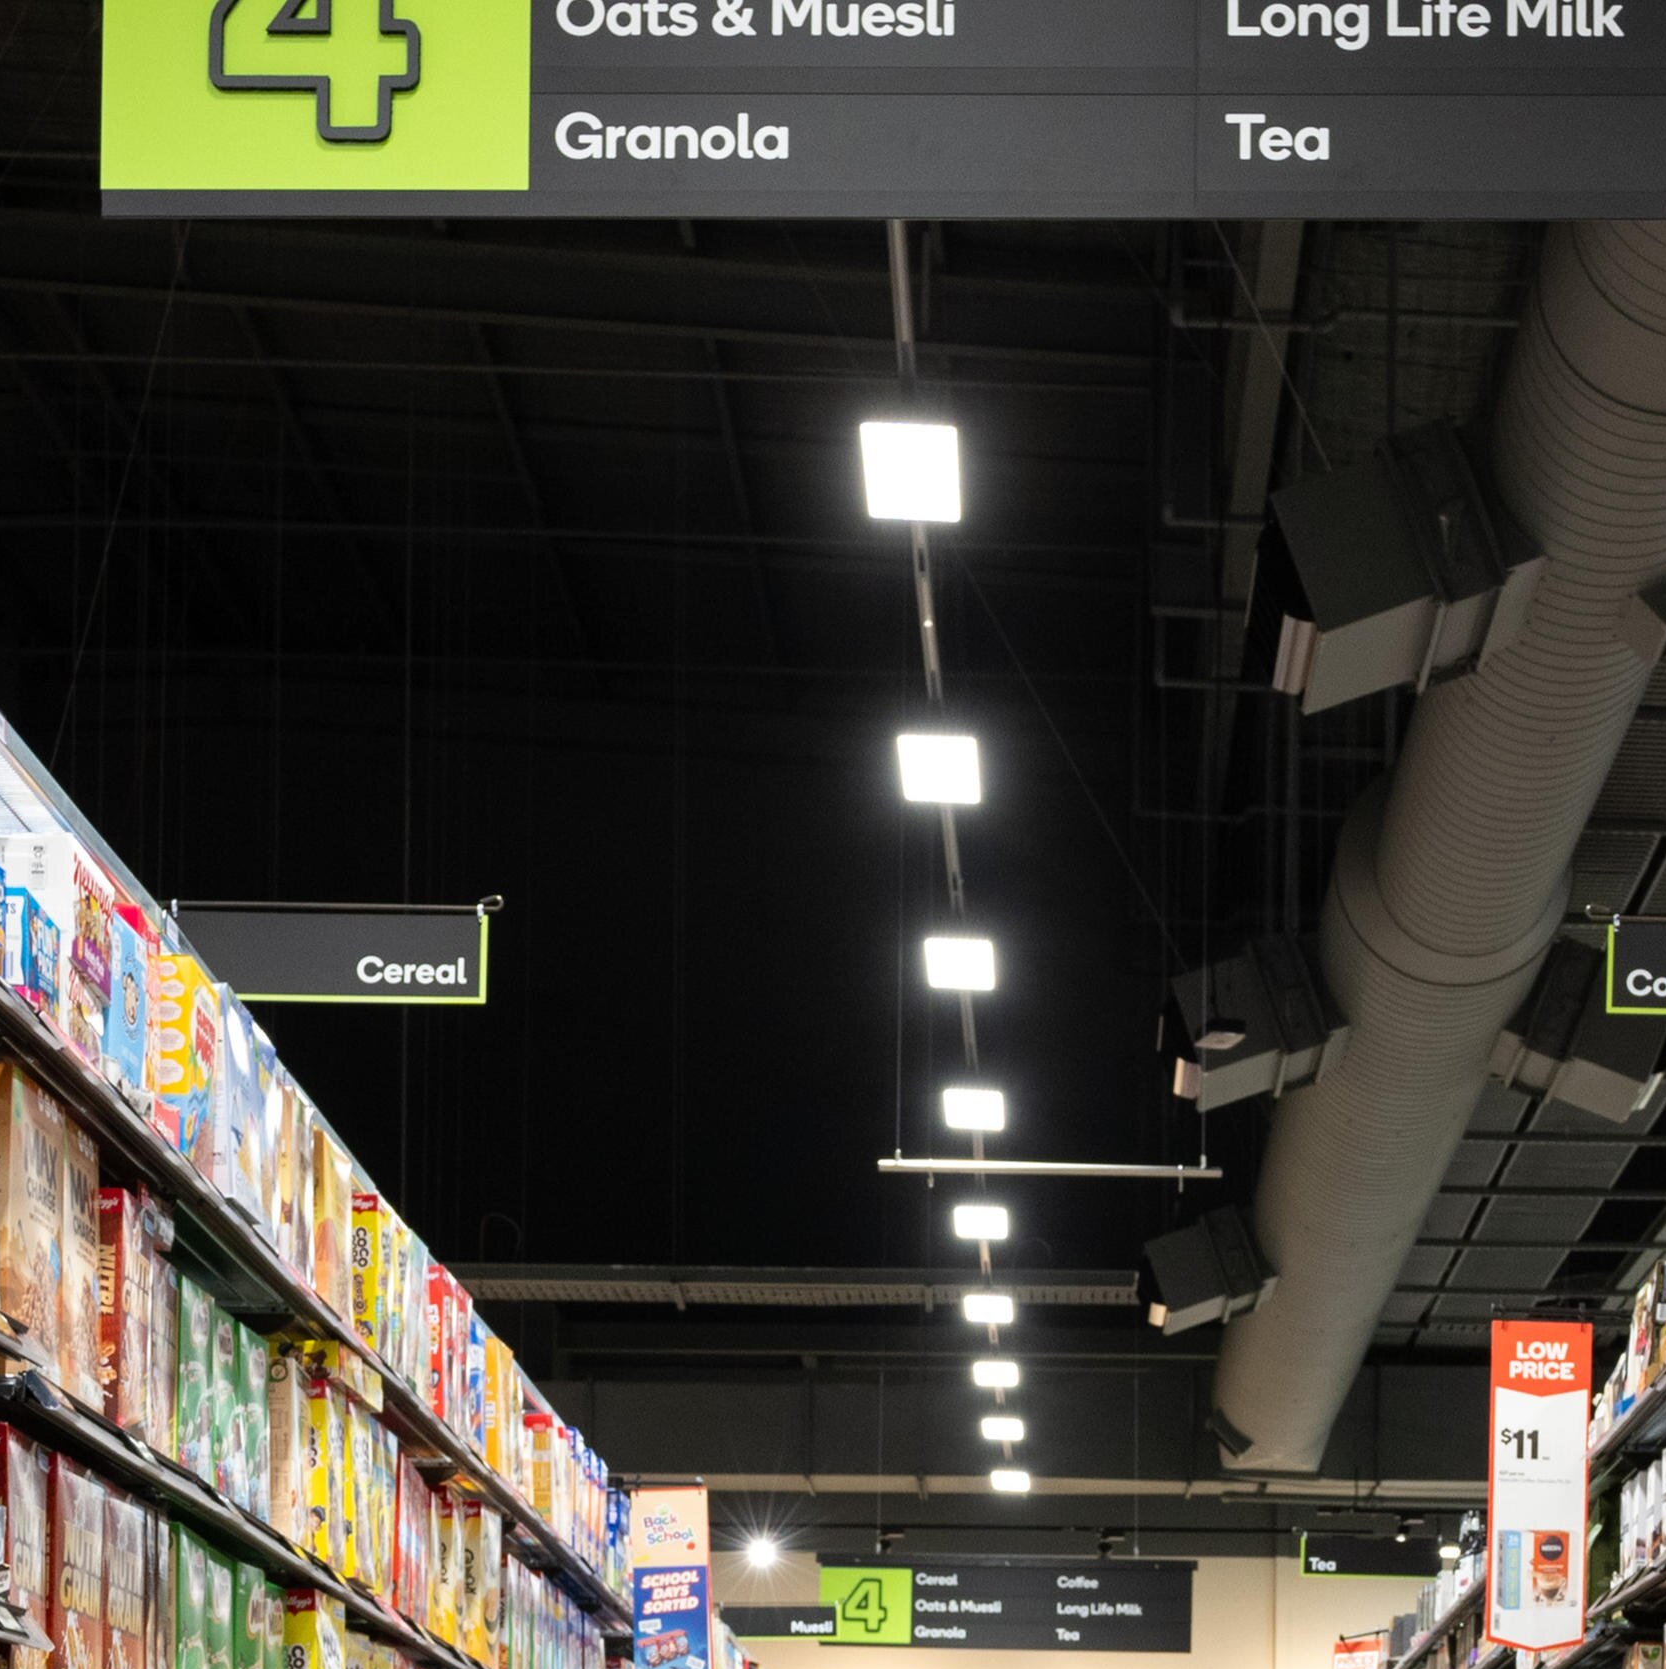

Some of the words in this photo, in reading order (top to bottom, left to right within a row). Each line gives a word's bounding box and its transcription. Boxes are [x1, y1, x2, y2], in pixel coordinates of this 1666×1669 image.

[555, 0, 697, 37] Oats
[712, 0, 758, 37] &
[771, 0, 955, 37] Muesli
[1227, 0, 1370, 51] Long
[1387, 0, 1491, 37] Life
[1507, 0, 1624, 37] Milk
[209, 0, 420, 143] 4
[555, 112, 790, 160] Granola
[1225, 113, 1330, 161] Tea
[356, 955, 467, 985] Cereal
[1516, 1341, 1568, 1361] LOW
[1509, 1361, 1575, 1380] PRICE
[643, 1514, 678, 1530] Back
[647, 1526, 695, 1546] School
[1308, 1556, 1337, 1572] Tea
[641, 1569, 699, 1590] SCHOOL
[916, 1573, 958, 1587] Cereal
[1057, 1576, 1099, 1590] Coffee
[651, 1583, 690, 1600] DAYS
[642, 1595, 699, 1615] SORTED
[842, 1577, 888, 1633] 4
[915, 1600, 945, 1613] Oats
[962, 1600, 1002, 1614] Muesli
[1057, 1603, 1087, 1618] Long
[1089, 1603, 1112, 1616] Life
[1114, 1603, 1142, 1616] Milk
[790, 1620, 833, 1634] Muesli
[915, 1625, 966, 1640] Granola
[1056, 1628, 1080, 1641] Tea
